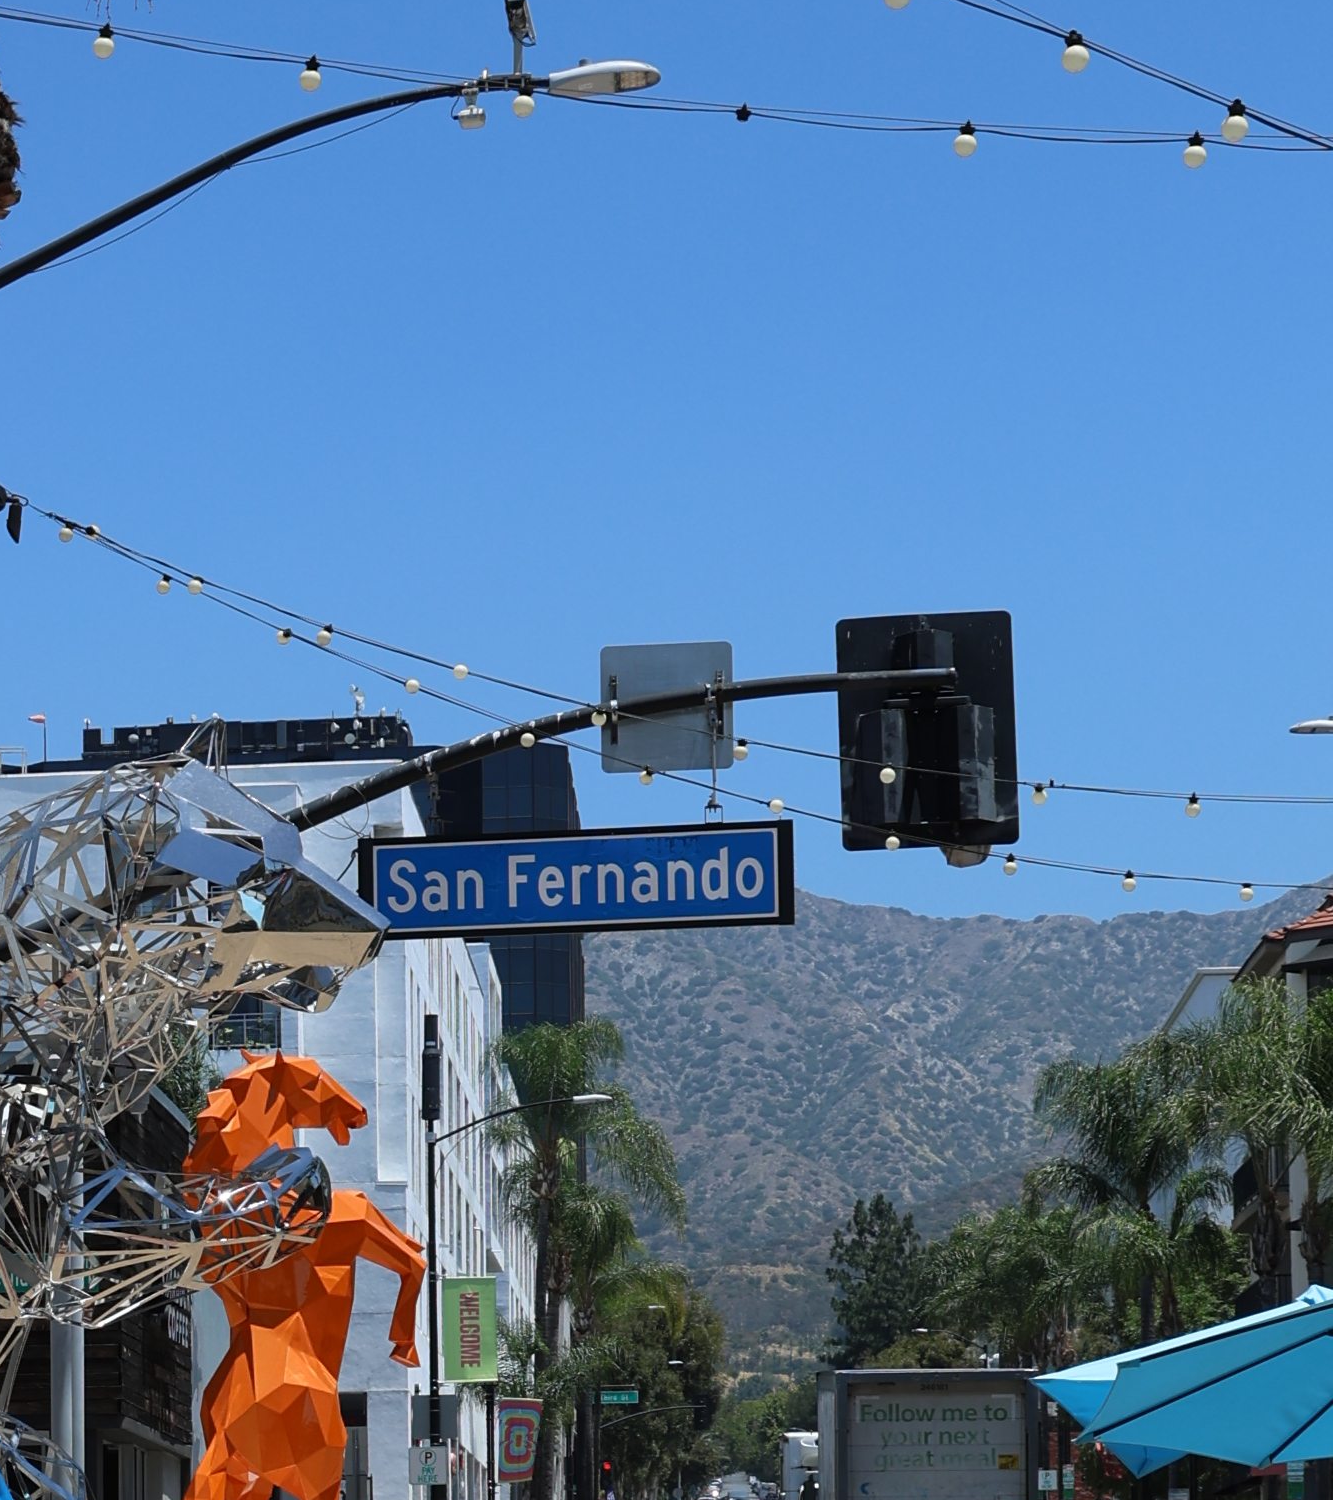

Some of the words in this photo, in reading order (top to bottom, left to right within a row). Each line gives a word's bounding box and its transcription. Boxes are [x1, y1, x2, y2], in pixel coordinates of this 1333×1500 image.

[387, 859, 484, 914] San
[507, 846, 765, 909] Fernando
[166, 1304, 189, 1349] COFFEE
[459, 1291, 481, 1368] WELCOME
[859, 1403, 935, 1423] Follow
[942, 1407, 978, 1422] me
[984, 1404, 1008, 1422] to
[882, 1429, 933, 1450] your
[939, 1428, 990, 1445] next
[421, 1466, 435, 1475] PAY
[875, 1451, 934, 1472] great
[941, 1448, 996, 1468] meal
[417, 1475, 437, 1483] HERE
